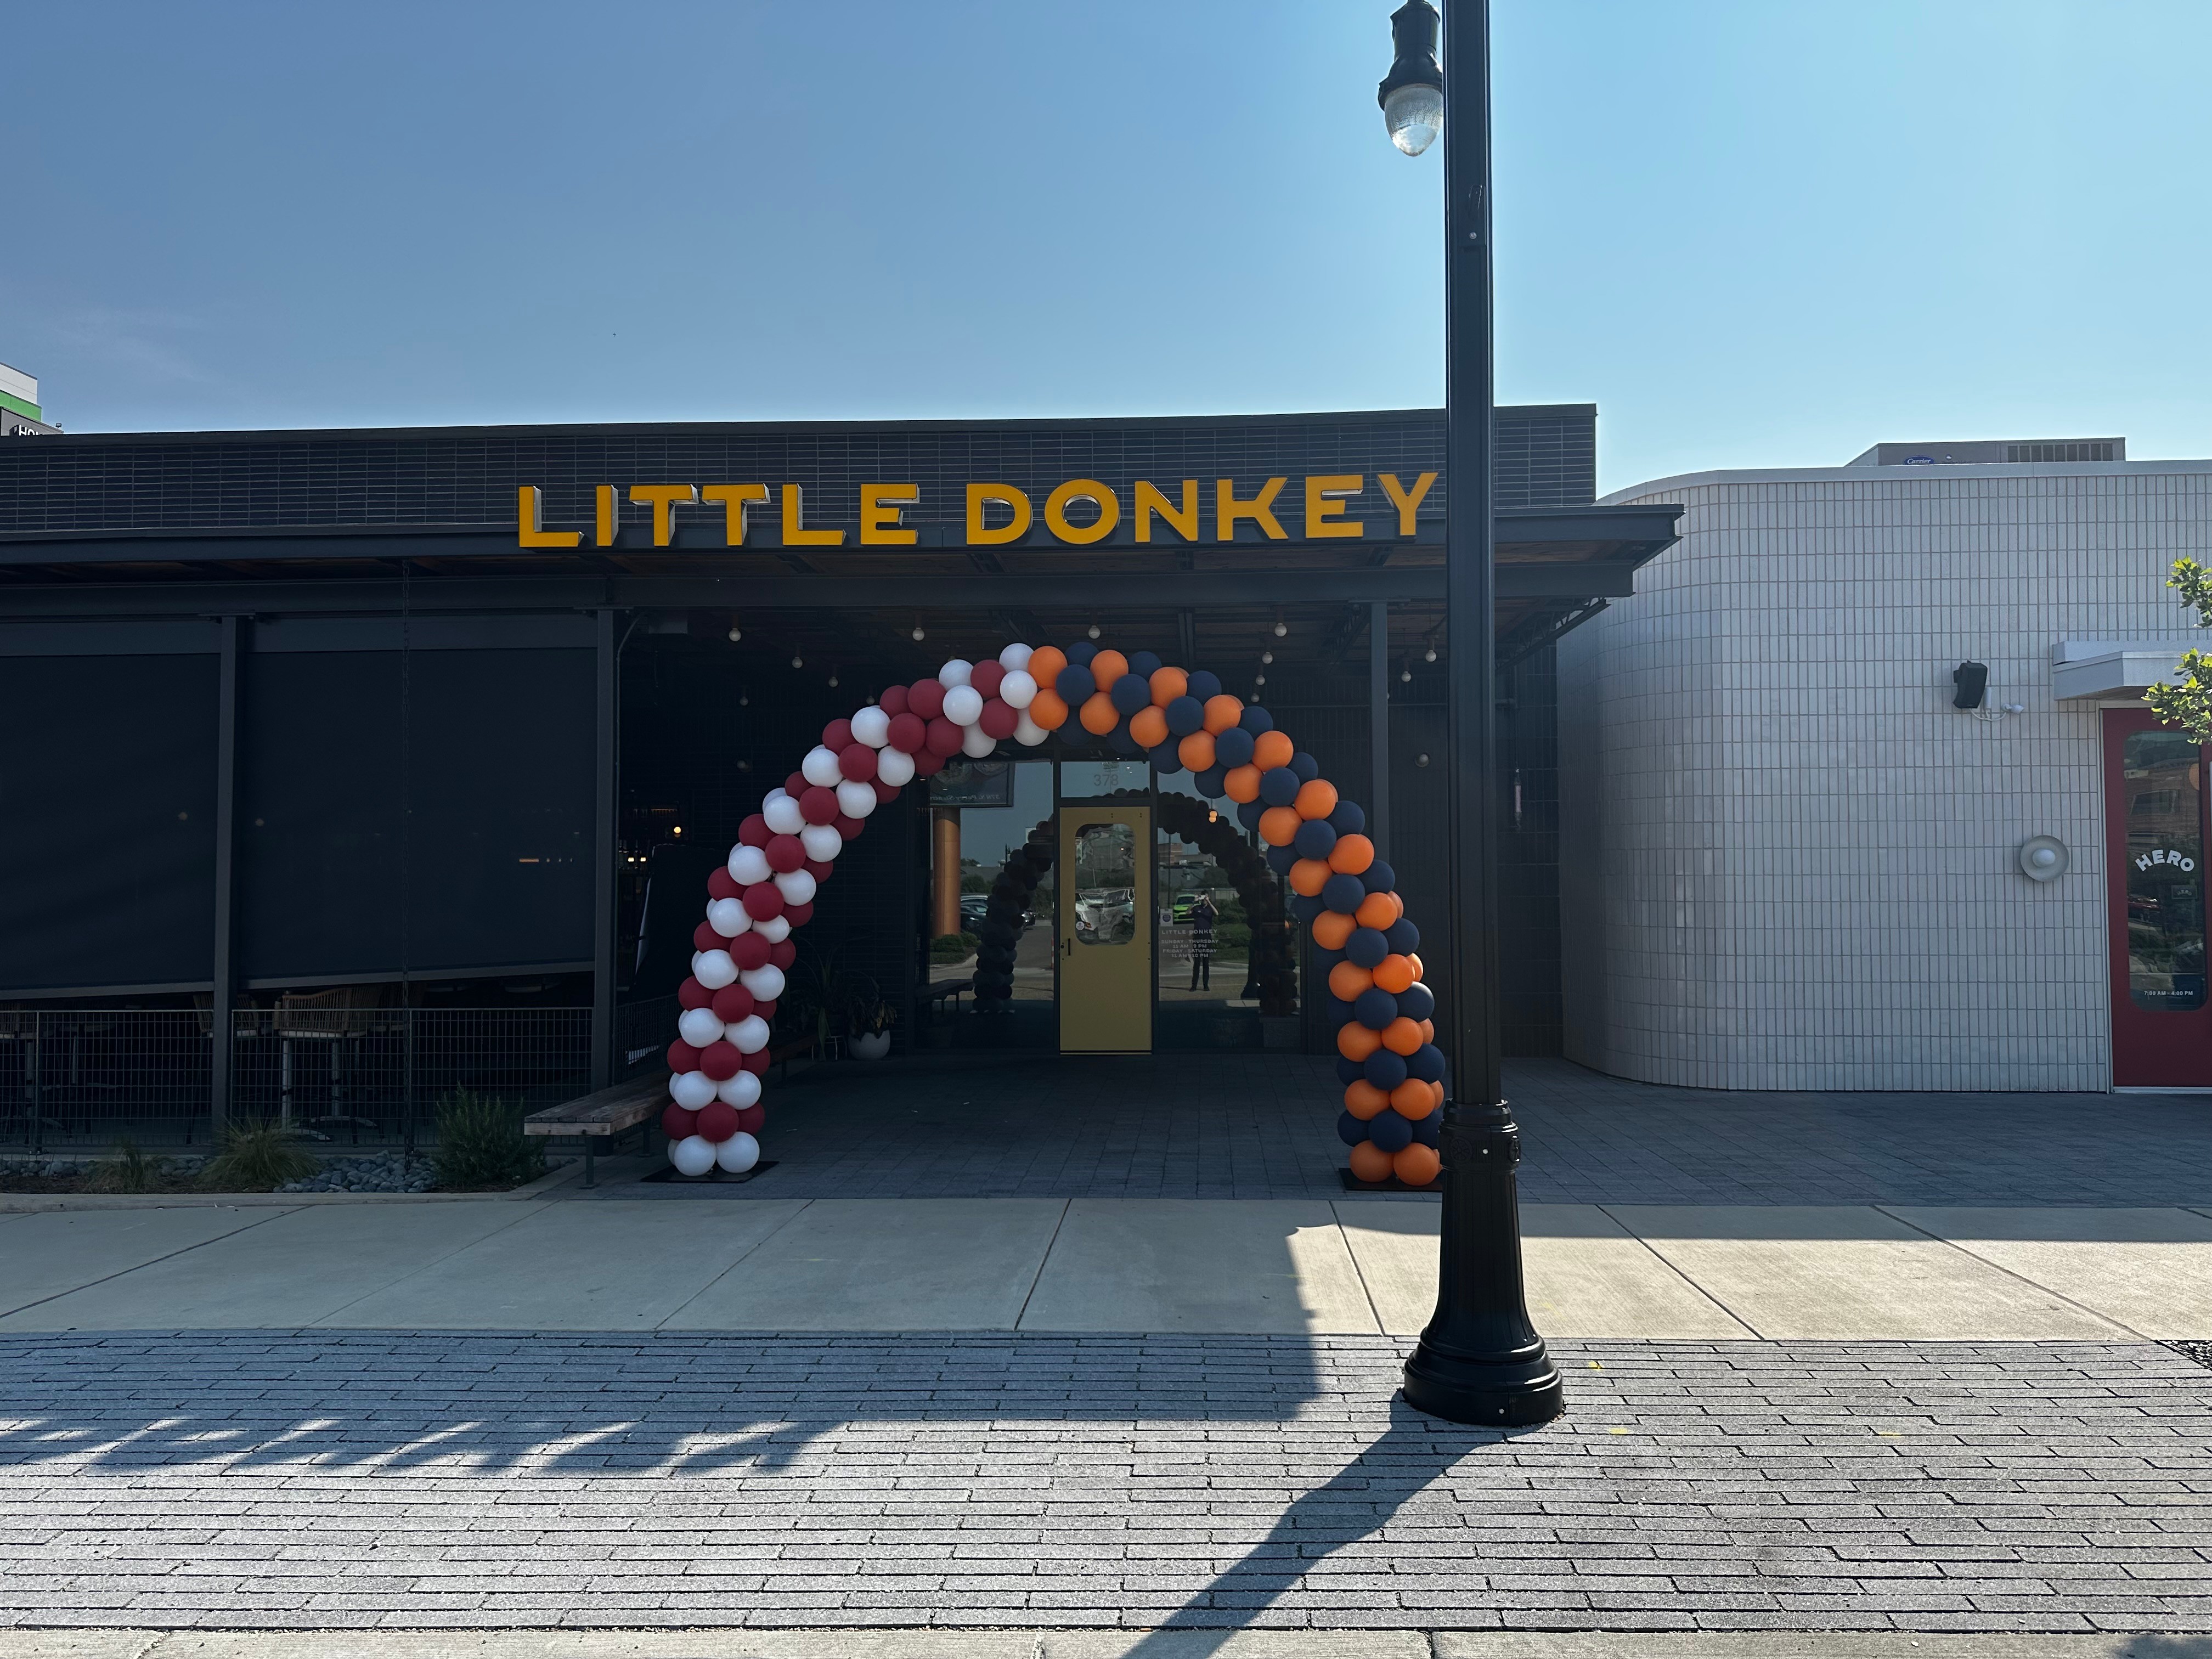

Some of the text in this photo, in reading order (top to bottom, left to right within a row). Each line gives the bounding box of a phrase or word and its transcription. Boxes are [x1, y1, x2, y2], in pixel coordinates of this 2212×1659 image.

[518, 471, 1438, 548] LITTLE DONKEY
[1093, 774, 1119, 786] 378
[2135, 849, 2194, 872] HERO
